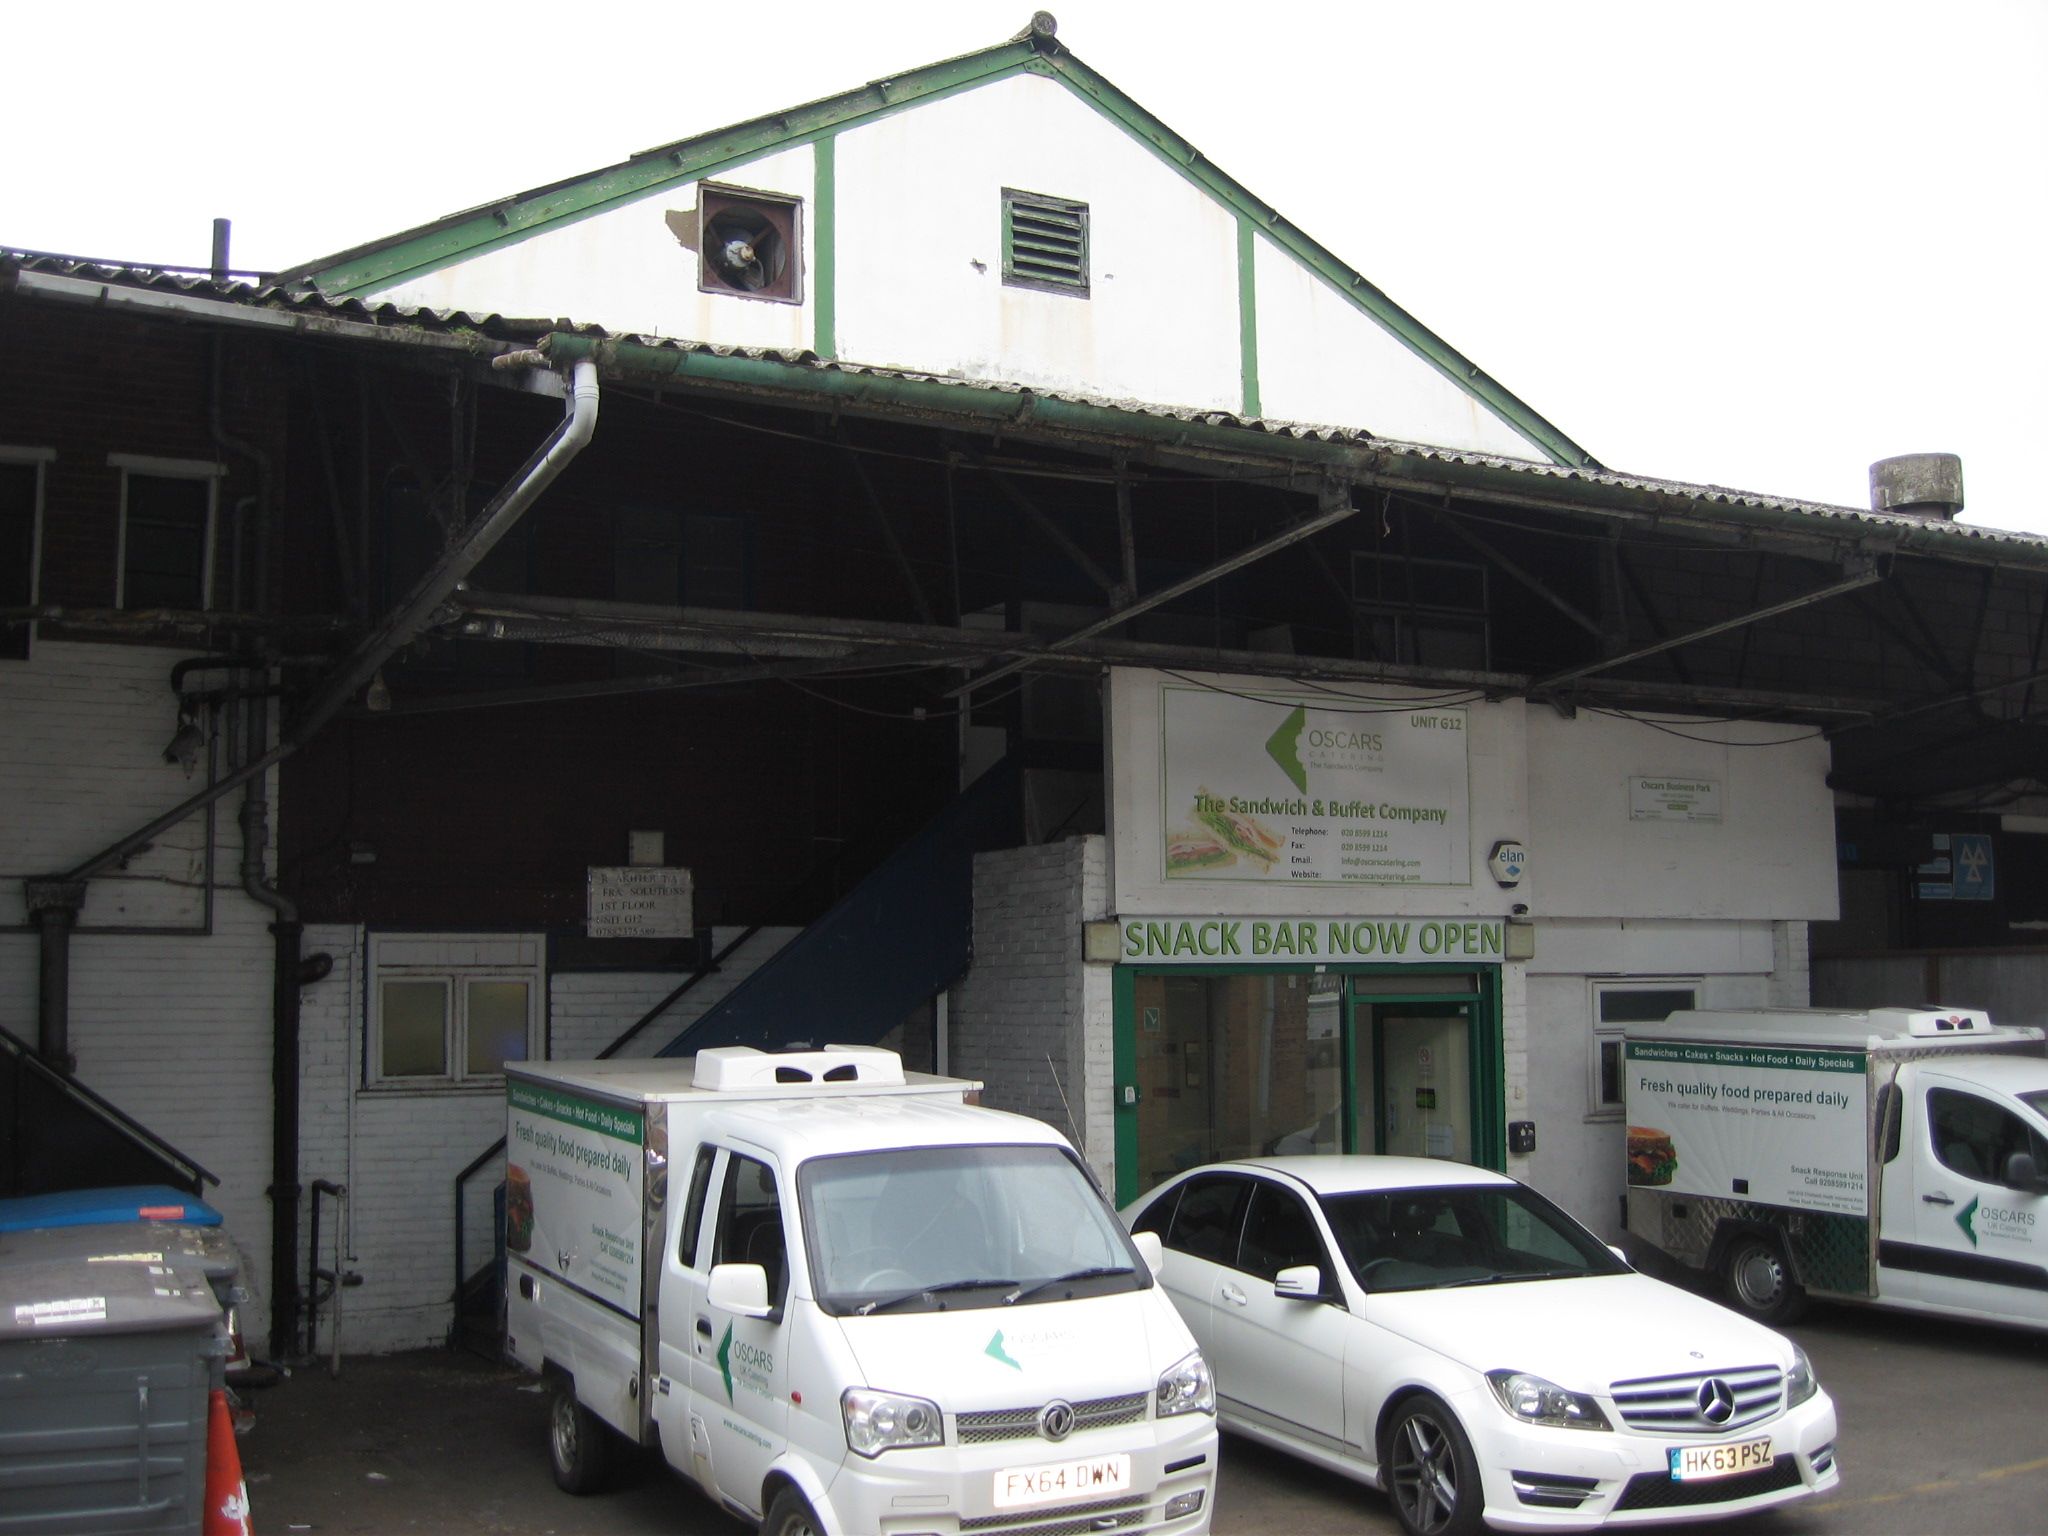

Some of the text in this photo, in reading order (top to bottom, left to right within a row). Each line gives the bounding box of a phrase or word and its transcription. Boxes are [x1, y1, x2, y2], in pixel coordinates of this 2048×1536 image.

[1411, 715, 1462, 730] UNIT G12
[1308, 730, 1383, 751] OSCARS
[1641, 781, 1665, 790] Oscars
[1696, 783, 1711, 792] Park
[1194, 795, 1447, 825] The Sandwich & Buffet Company
[1291, 827, 1329, 837] Telephone:
[1291, 842, 1306, 850] Fax:
[1291, 856, 1313, 864] Email:
[1500, 850, 1525, 863] elan
[1291, 870, 1322, 879] Website:
[622, 901, 656, 911] FLOOR
[1126, 921, 1501, 956] SNACK BAR NOW OPEN
[1634, 1047, 1855, 1069] Sandwiches Cakes Snacks Hot Food Daily Specials
[1640, 1078, 1849, 1109] Fresh quality food prepared daily
[575, 1106, 585, 1120] Hot
[585, 1108, 598, 1123] Food
[600, 1112, 613, 1131] Daily
[613, 1116, 636, 1135] Specials
[515, 1121, 632, 1182] Fresh quality food prepared daily
[1791, 1165, 1863, 1181] Snack Response Unit
[1804, 1177, 1818, 1185] Call
[1981, 1207, 2035, 1226] OSCARS
[734, 1340, 774, 1373] OSCARS
[1686, 1440, 1772, 1472] HK63 PSZ
[1007, 1462, 1119, 1498] FX64 DWN
